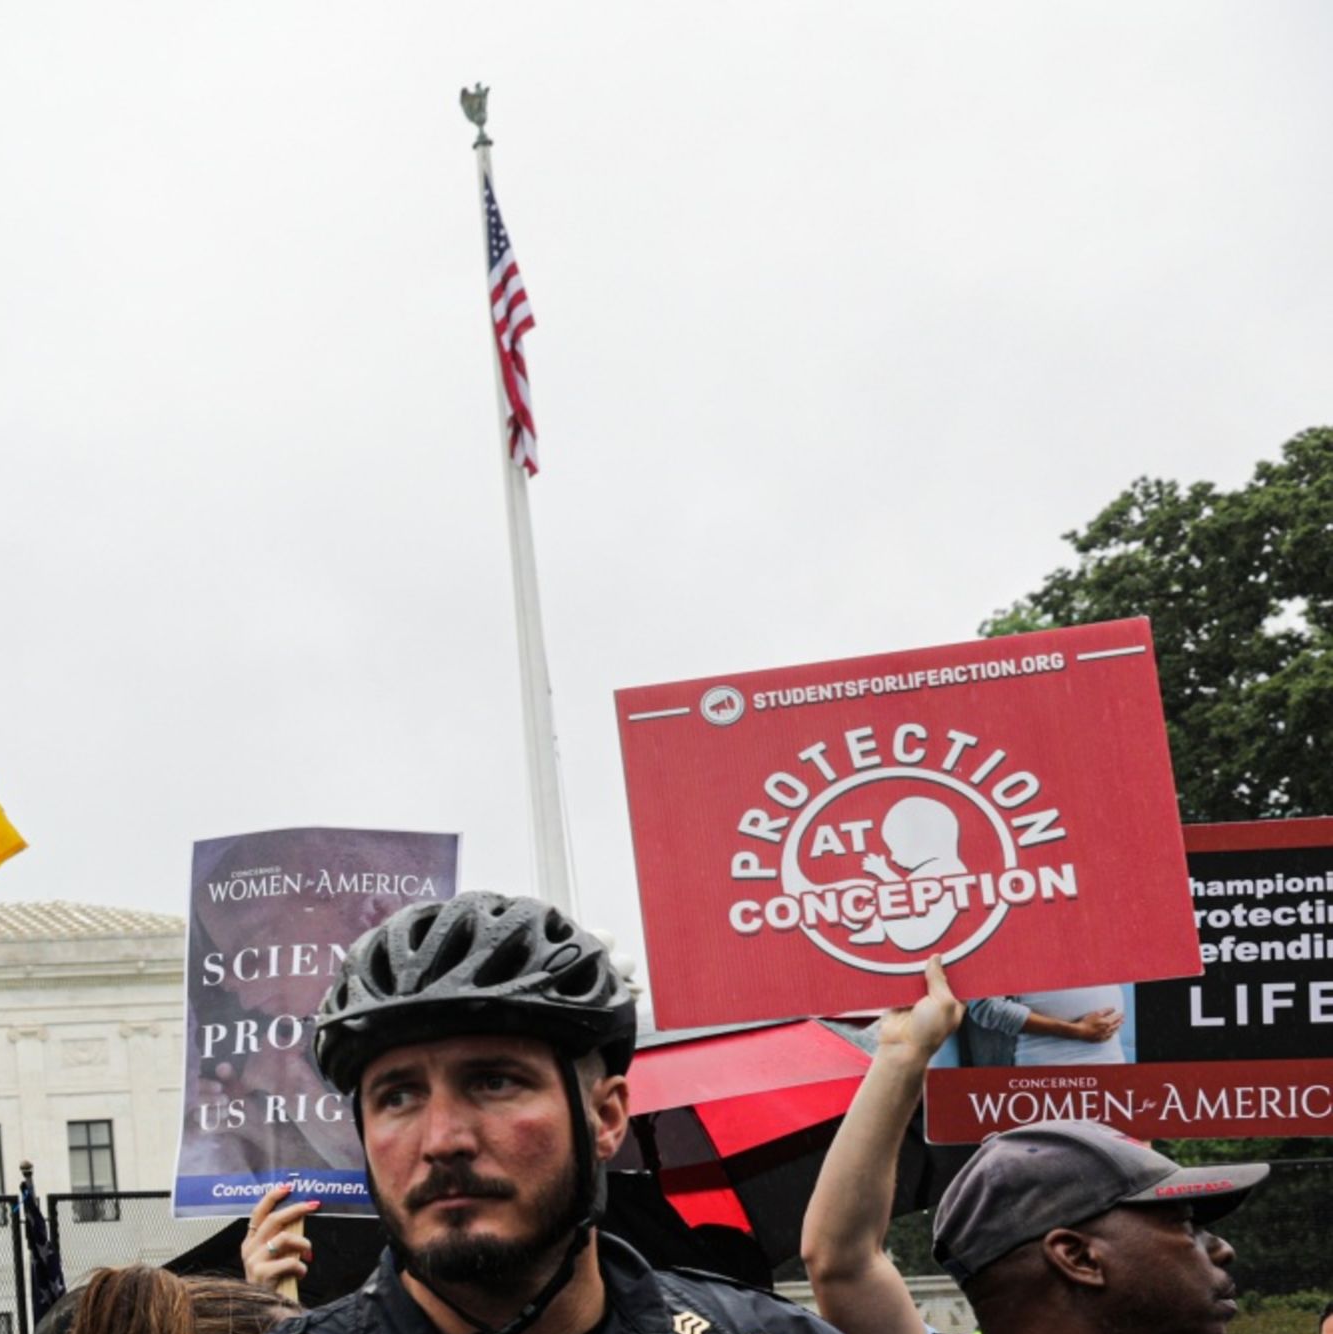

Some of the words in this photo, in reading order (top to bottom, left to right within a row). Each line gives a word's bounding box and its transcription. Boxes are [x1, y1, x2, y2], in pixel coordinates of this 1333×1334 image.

[752, 653, 1065, 710] STUDENTSFORLIFEACTION.ORG
[731, 722, 1067, 882] PROTECTION
[809, 820, 875, 858] AT
[208, 872, 303, 903] WOMEN
[315, 868, 437, 898] AMERICA
[729, 862, 1078, 935] CONCEPTION
[1193, 900, 1333, 928] rotecti
[1200, 933, 1333, 964] efendi
[1190, 981, 1333, 1027] LIFE
[201, 1014, 320, 1059] PRO
[1008, 1077, 1098, 1089] CONCERNED
[200, 1099, 245, 1131] US
[264, 1092, 356, 1124] RIG
[968, 1089, 1135, 1124] WOMEN
